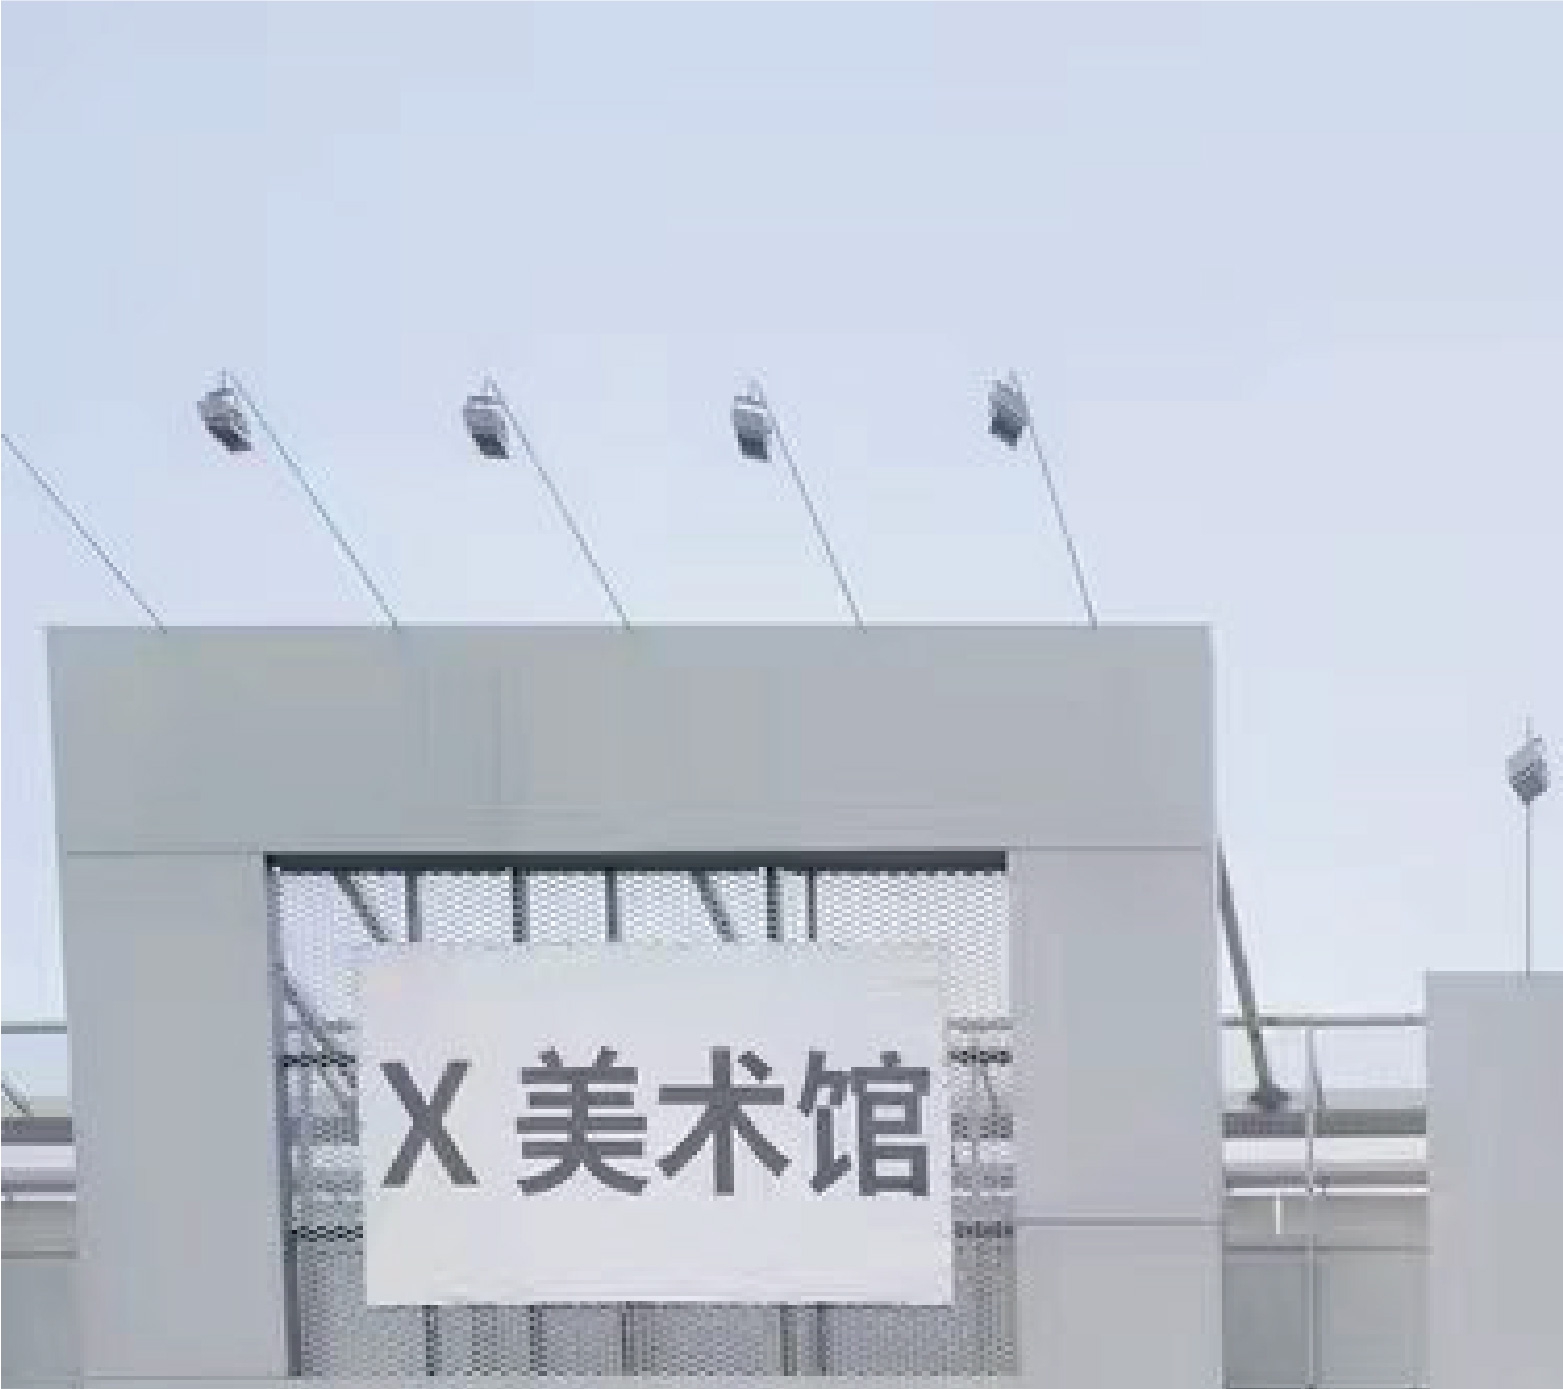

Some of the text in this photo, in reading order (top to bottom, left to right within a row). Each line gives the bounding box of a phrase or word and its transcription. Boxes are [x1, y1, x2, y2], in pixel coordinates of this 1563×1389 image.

[379, 1045, 932, 1198] X 美术馆
